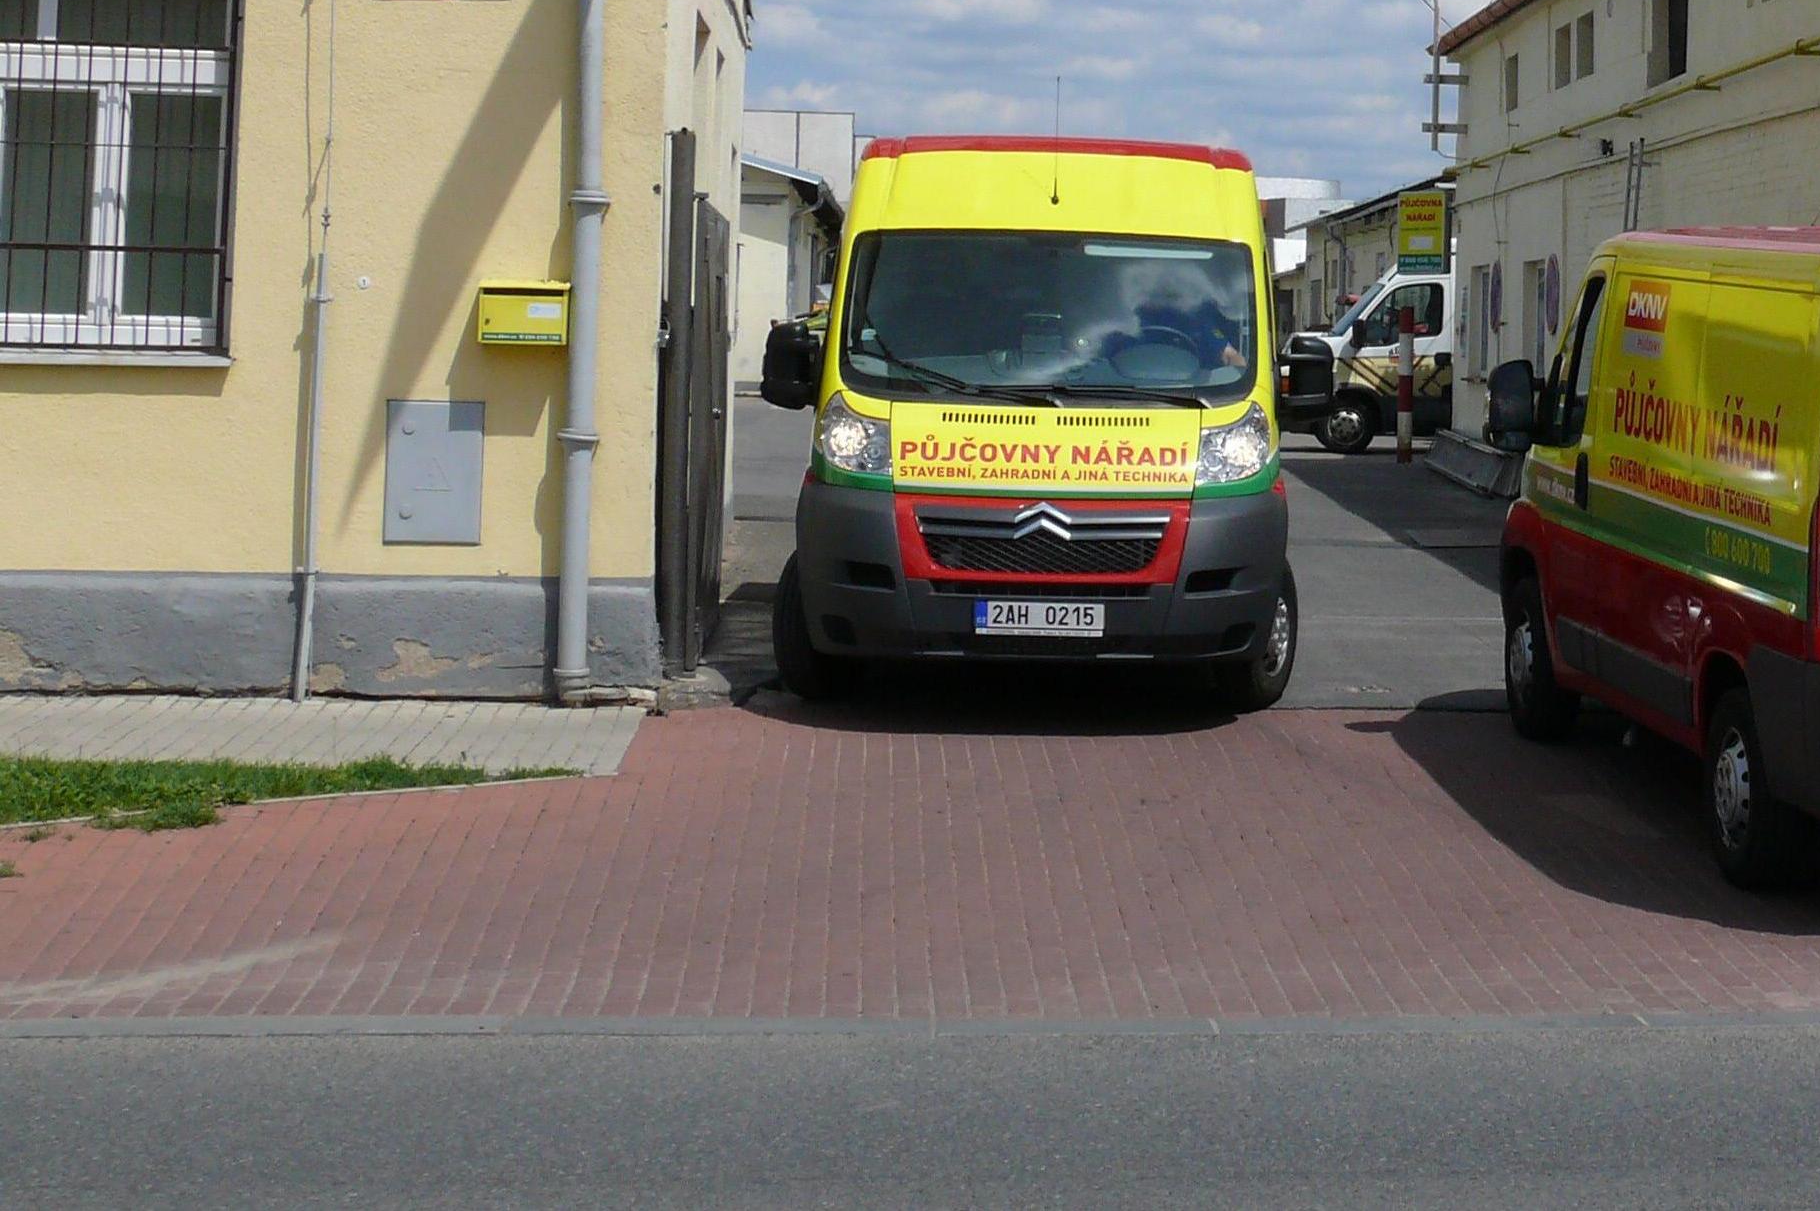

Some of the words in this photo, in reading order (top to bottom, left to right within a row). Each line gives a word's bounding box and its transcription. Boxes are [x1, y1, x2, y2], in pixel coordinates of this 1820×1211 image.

[1628, 291, 1667, 321] DKNV
[1614, 370, 1700, 457] PŮJČOVNY
[1703, 395, 1782, 472] NÁŘADÍ
[900, 435, 1060, 463] PŮJČOVNY
[1071, 440, 1189, 467] NÁŘADÍ
[900, 465, 976, 480] STAVEBNÍ,
[980, 467, 1057, 481] ZAHRADNÍ
[1061, 471, 1070, 481] A
[1075, 467, 1108, 482] JINÁ
[1113, 470, 1188, 483] TECHNIKA
[1723, 489, 1771, 527] TECHNIKA
[992, 604, 1029, 625] 2AH
[1045, 606, 1094, 626] 0215
